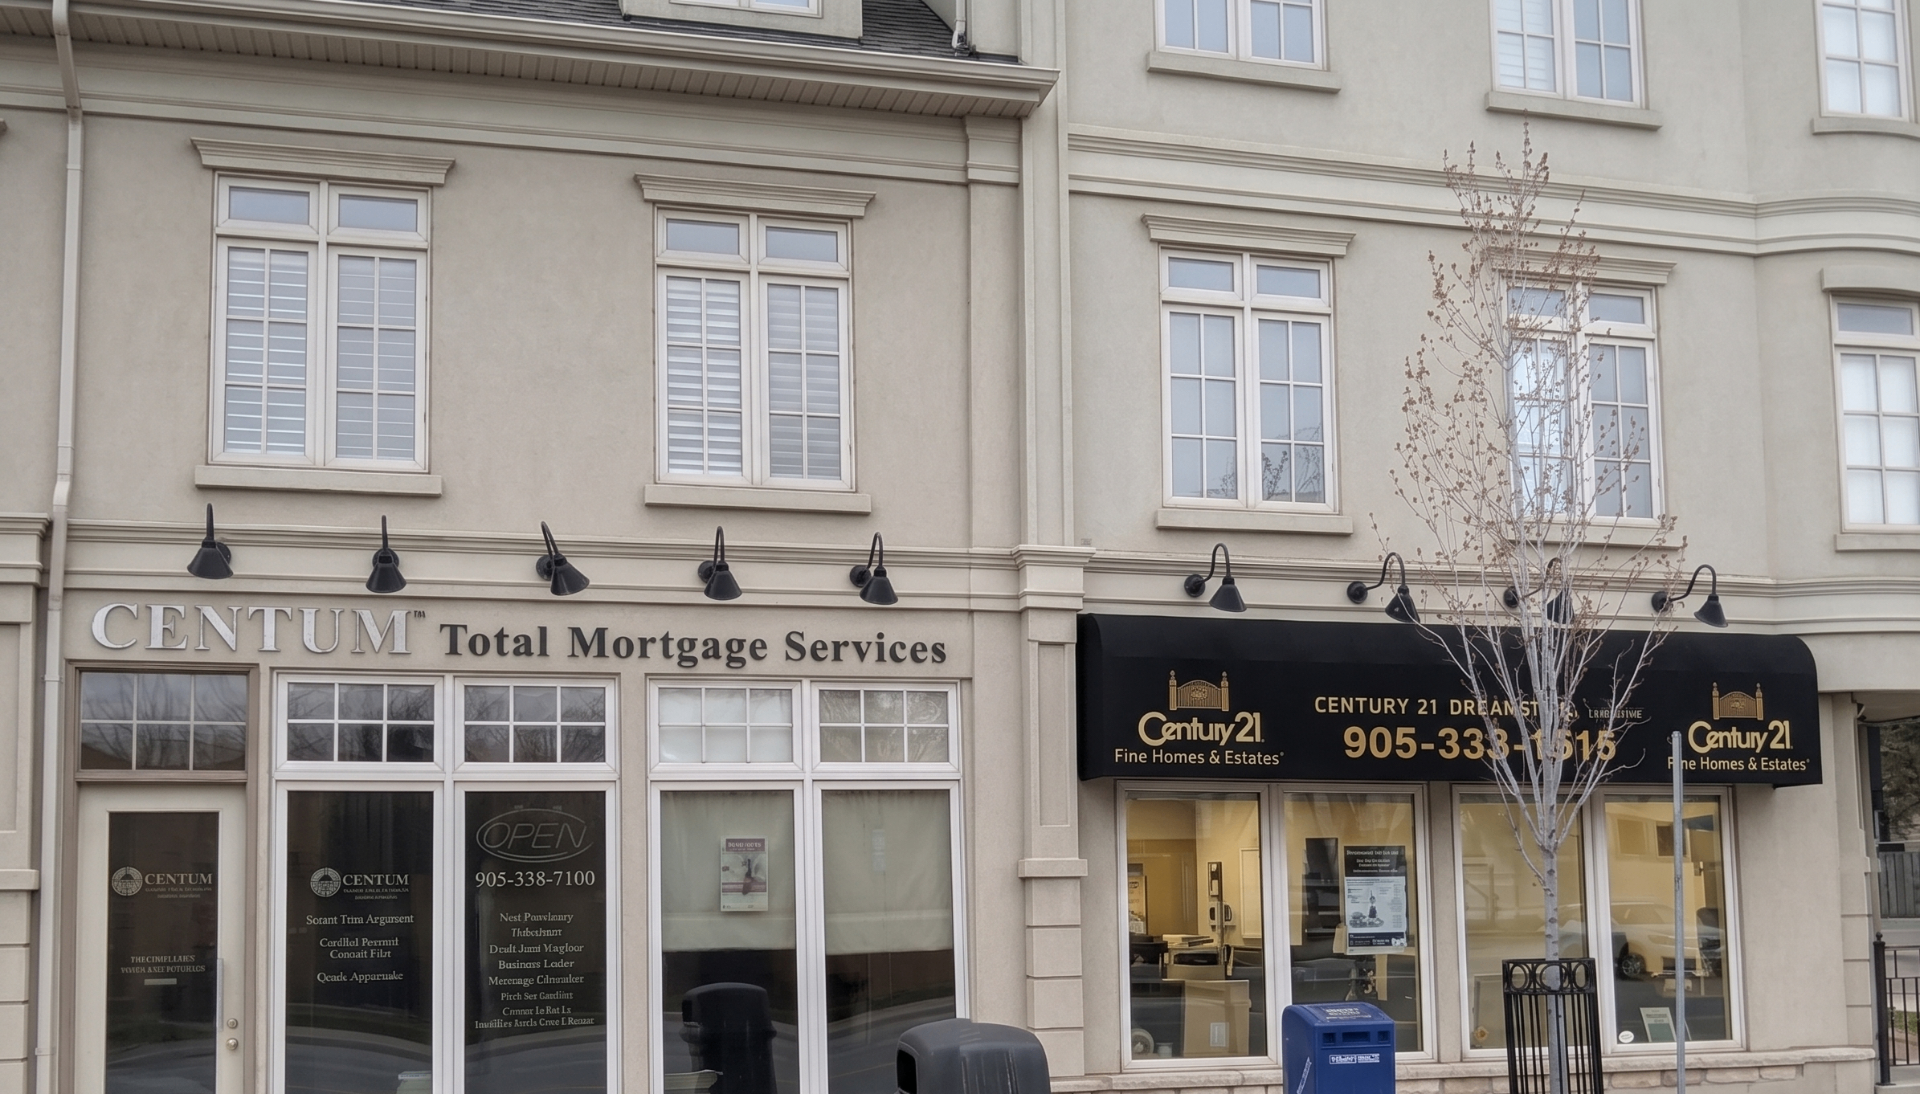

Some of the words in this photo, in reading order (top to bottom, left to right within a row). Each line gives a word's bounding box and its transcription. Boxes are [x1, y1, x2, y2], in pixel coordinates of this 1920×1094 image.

[91, 602, 412, 654] CENTUM
[440, 624, 550, 657] Total
[567, 626, 768, 669] Mortgage
[785, 630, 947, 664] Services
[1314, 696, 1409, 715] CENTURY
[1417, 699, 1438, 715] 21
[1138, 711, 1236, 746] Century
[1235, 711, 1262, 742] 21
[1688, 720, 1769, 754] Century
[1768, 720, 1790, 749] 21
[1114, 748, 1147, 763] Fine
[1152, 749, 1205, 764] Homes
[1209, 750, 1220, 764] &
[1225, 750, 1280, 765] Estates
[1667, 756, 1696, 770] Fne
[1700, 757, 1744, 770] Homes
[1748, 757, 1757, 770] &
[1761, 757, 1807, 771] Estates
[483, 822, 586, 849] OPEN
[145, 873, 212, 885] CENTUM
[343, 874, 409, 886] CENTUM
[475, 870, 595, 887] 905-338-7100
